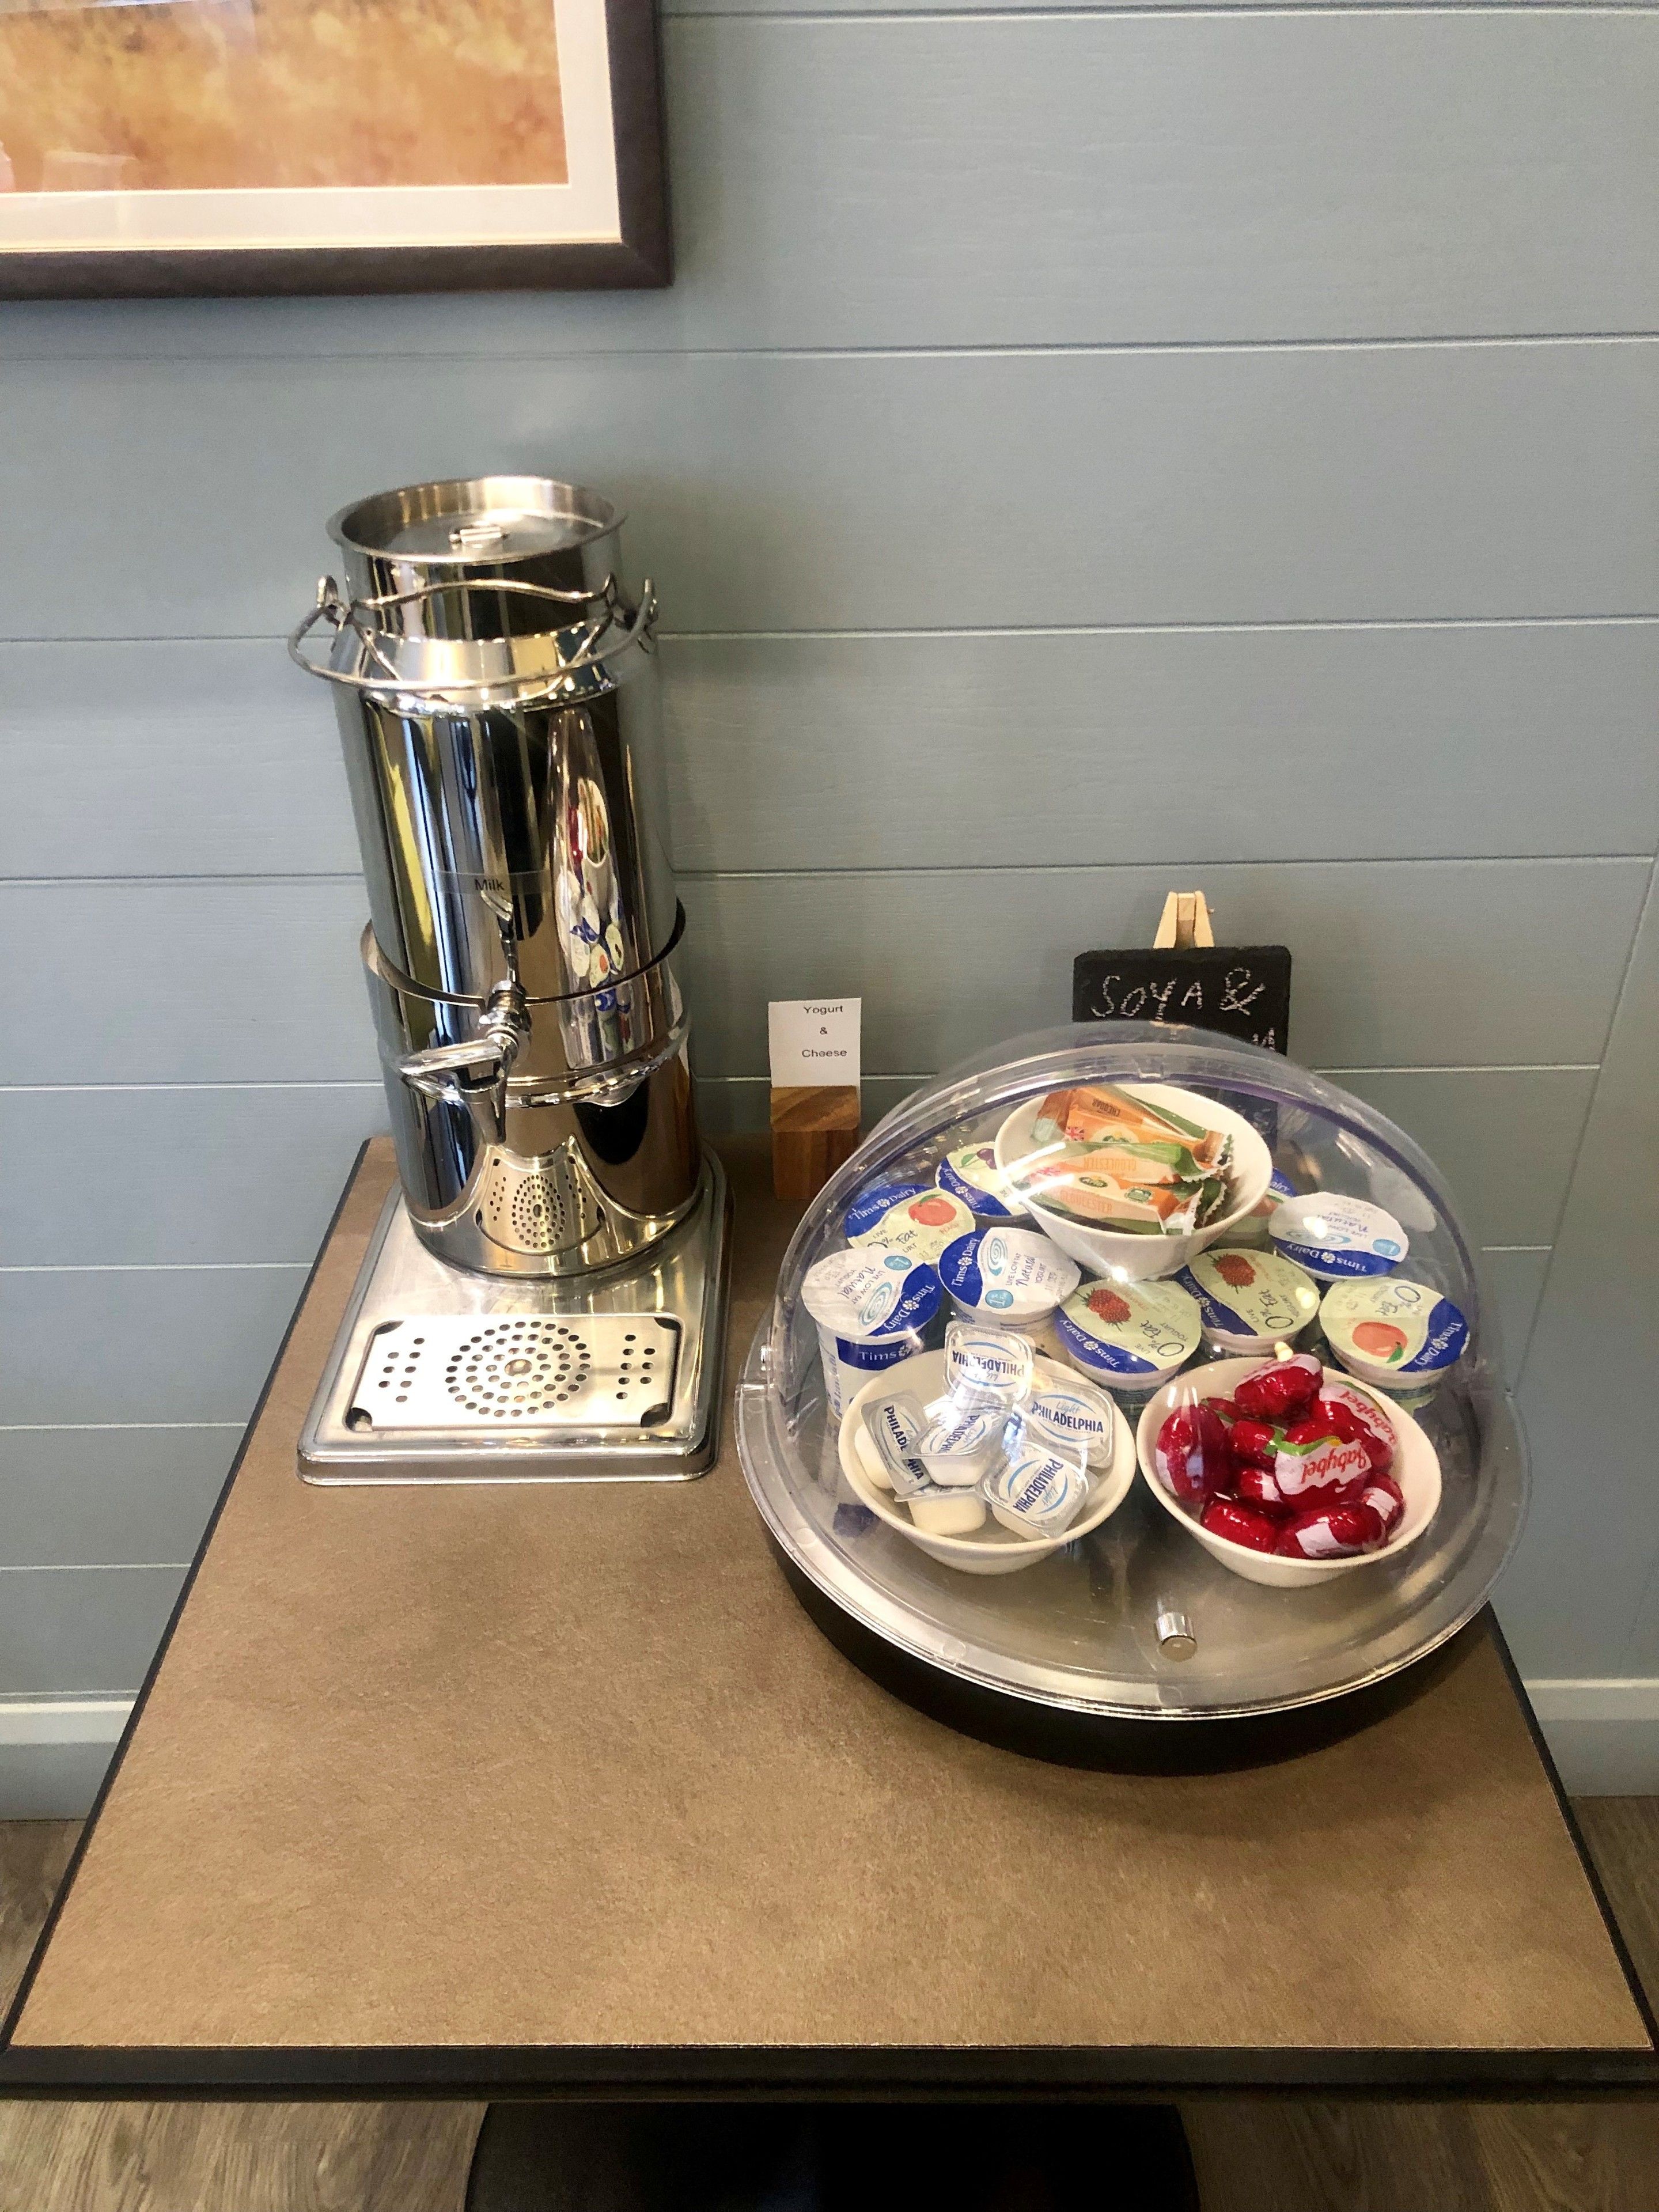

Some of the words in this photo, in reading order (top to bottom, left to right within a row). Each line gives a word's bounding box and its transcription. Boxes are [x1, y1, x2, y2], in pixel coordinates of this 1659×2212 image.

[475, 878, 504, 891] Milk
[804, 1005, 843, 1015] Yogurt
[820, 1027, 828, 1035] &
[801, 1050, 847, 1058] Cheese
[1092, 1098, 1120, 1117] CHEDDAR
[1084, 1157, 1137, 1172] GLOUCESTER
[1271, 1180, 1290, 1192] airy
[851, 1204, 880, 1219] Tims
[889, 1187, 916, 1203] Dairy
[1059, 1190, 1112, 1213] GLOUCESTER
[895, 1230, 918, 1244] Fat
[1286, 1243, 1320, 1259] Dairy
[951, 1266, 968, 1287] Tims
[962, 1238, 981, 1257] Dairy
[1016, 1256, 1036, 1286] Natural
[1335, 1257, 1368, 1272] Tims
[838, 1266, 877, 1300] Natural
[1035, 1263, 1047, 1284] YOGURT
[915, 1284, 936, 1302] Tims
[1183, 1273, 1202, 1300] Dairy
[883, 1309, 909, 1332] Dairy
[1204, 1307, 1224, 1328] Tims
[1246, 1308, 1260, 1324] LIVE
[1060, 1319, 1088, 1342] Dairy
[1141, 1320, 1161, 1339] Fat
[1161, 1322, 1189, 1342] YOGURT
[1440, 1323, 1463, 1342] Tims
[859, 1350, 896, 1361] Tims
[1096, 1347, 1120, 1368] Tims
[1134, 1343, 1150, 1355] LIVE
[1415, 1347, 1440, 1366] Dairy
[952, 1350, 1025, 1378] PHILADELHIA
[1055, 1400, 1081, 1414] Light
[1032, 1401, 1104, 1433] PHILADELPHIA
[884, 1404, 925, 1480] PHILADHIA
[1013, 1458, 1065, 1514] PHILADELPHIA
[1041, 1486, 1058, 1506] Light
